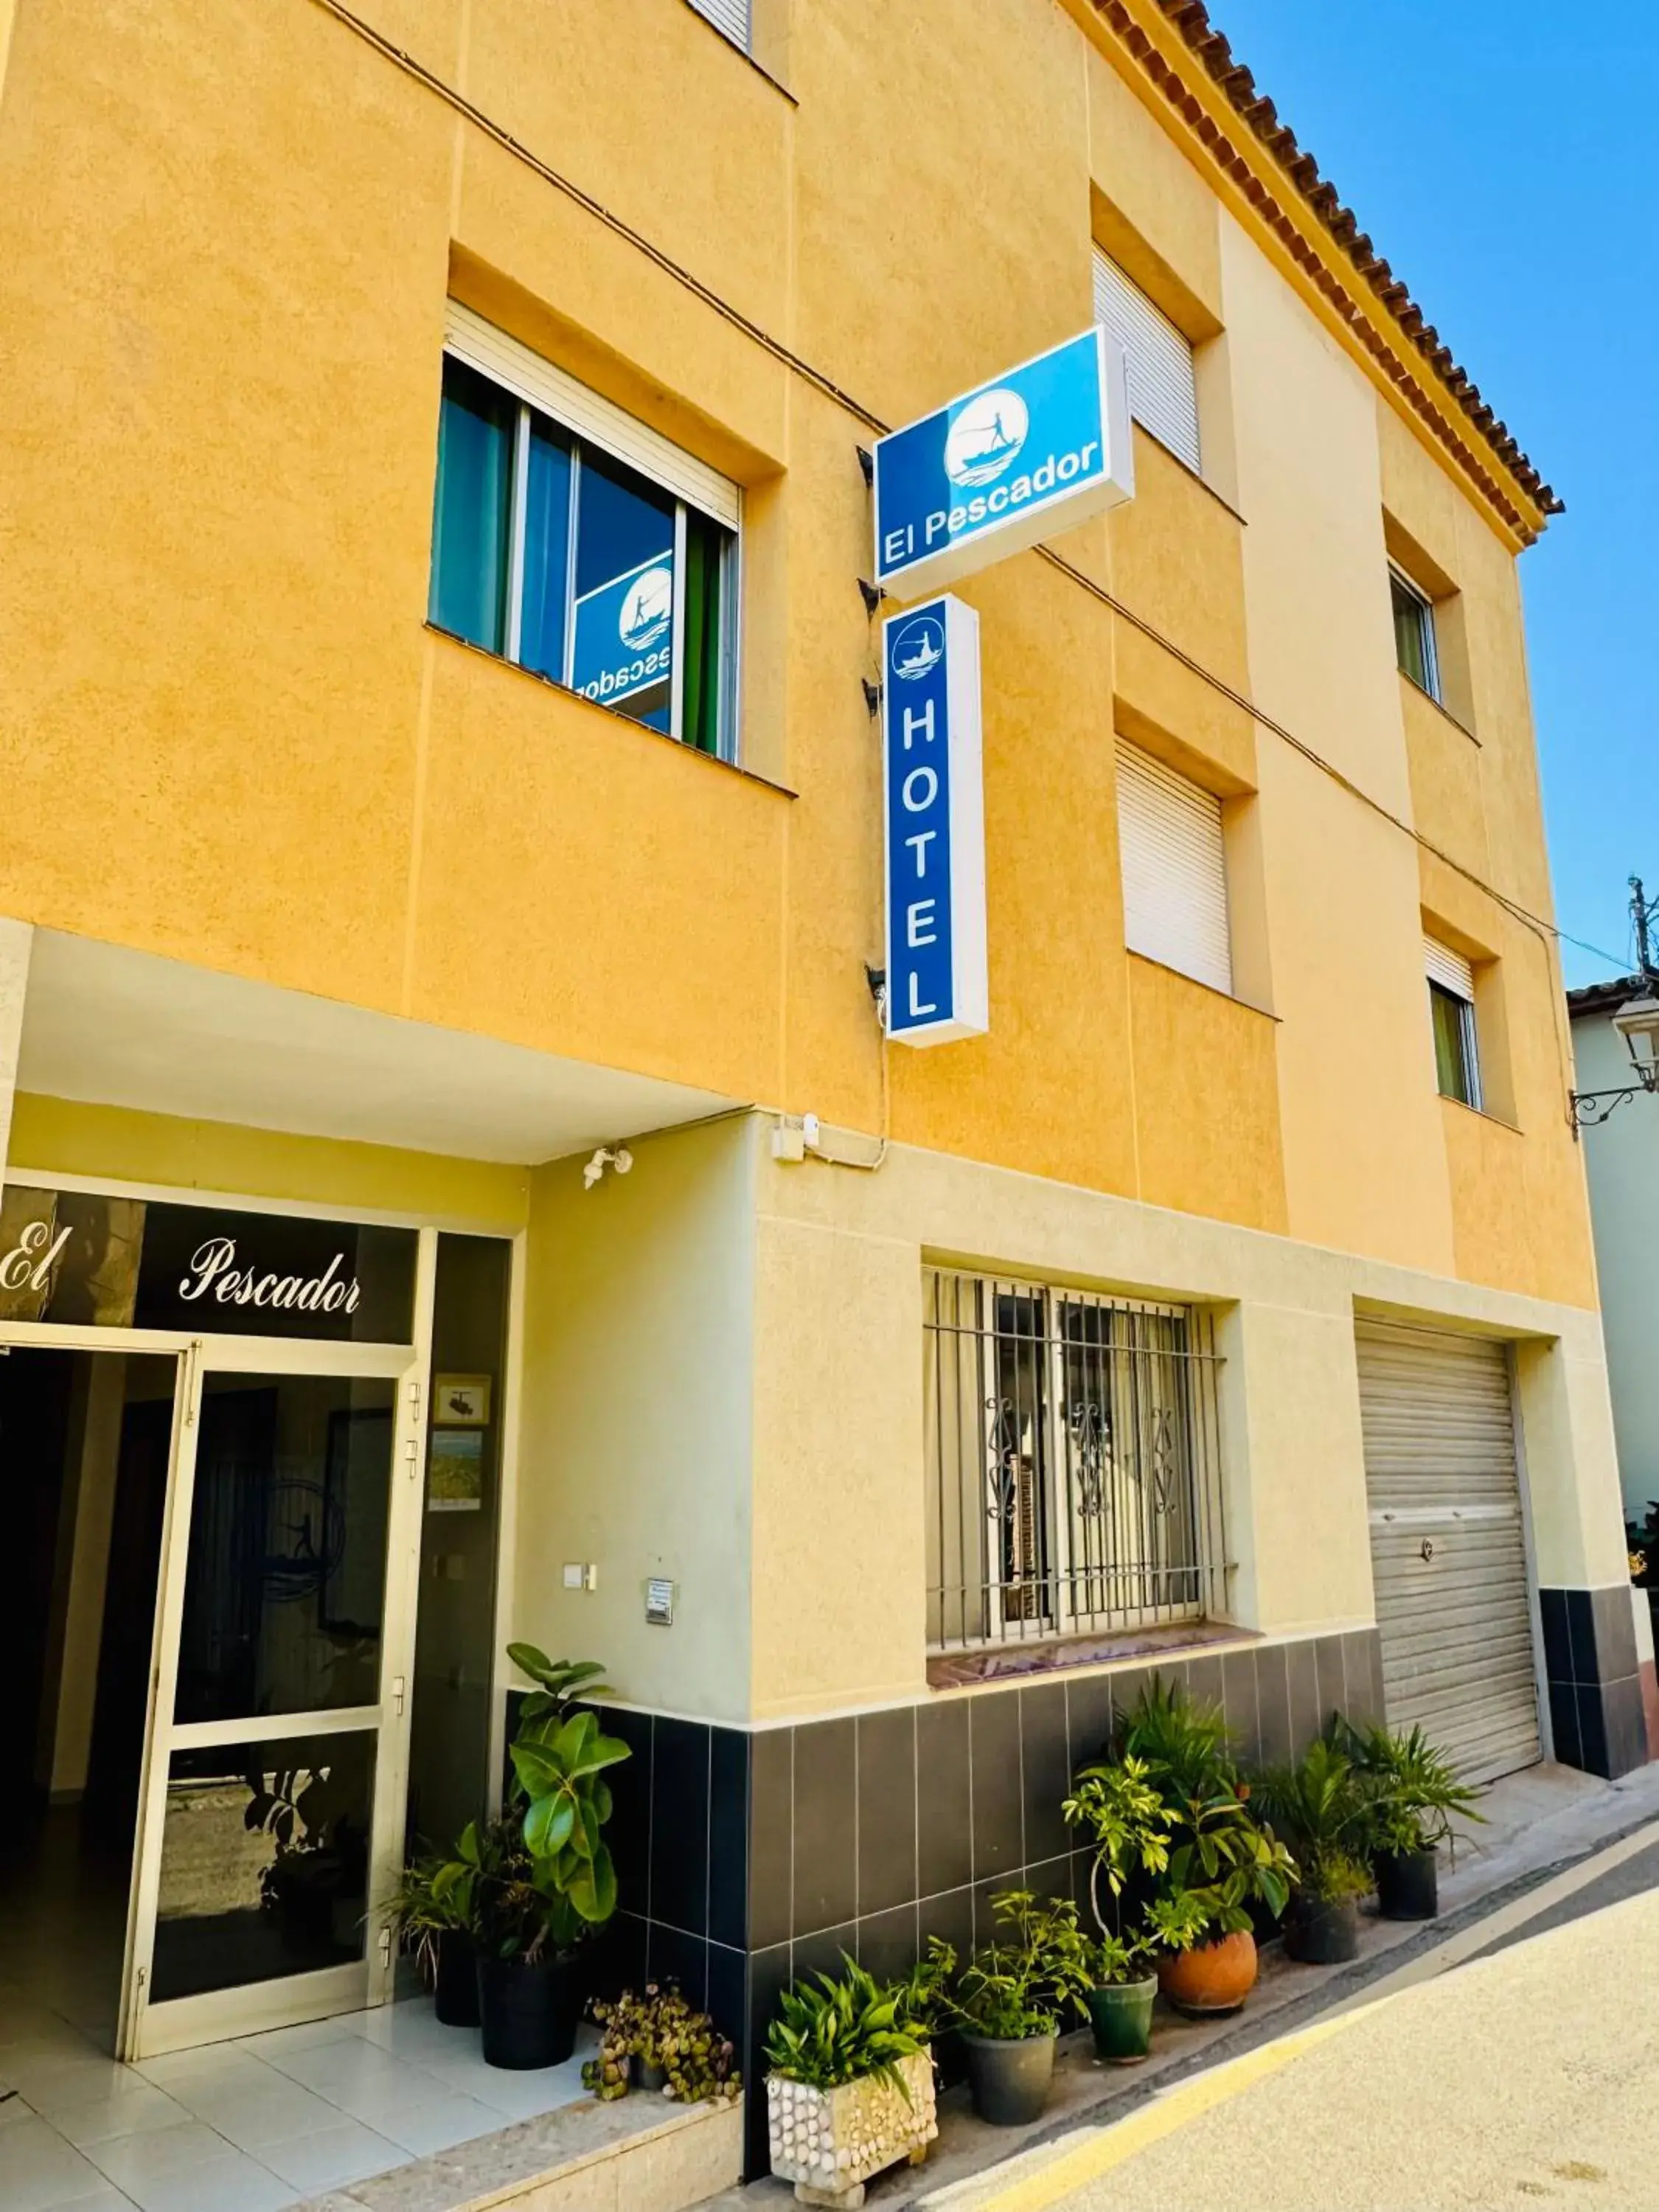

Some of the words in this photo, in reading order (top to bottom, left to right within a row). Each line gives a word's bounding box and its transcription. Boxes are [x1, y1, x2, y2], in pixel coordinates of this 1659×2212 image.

[885, 524, 914, 565] El
[925, 440, 1098, 546] Pescador
[902, 698, 938, 1018] HOTEL
[0, 1222, 73, 1290] El
[179, 1237, 361, 1314] Pescador
